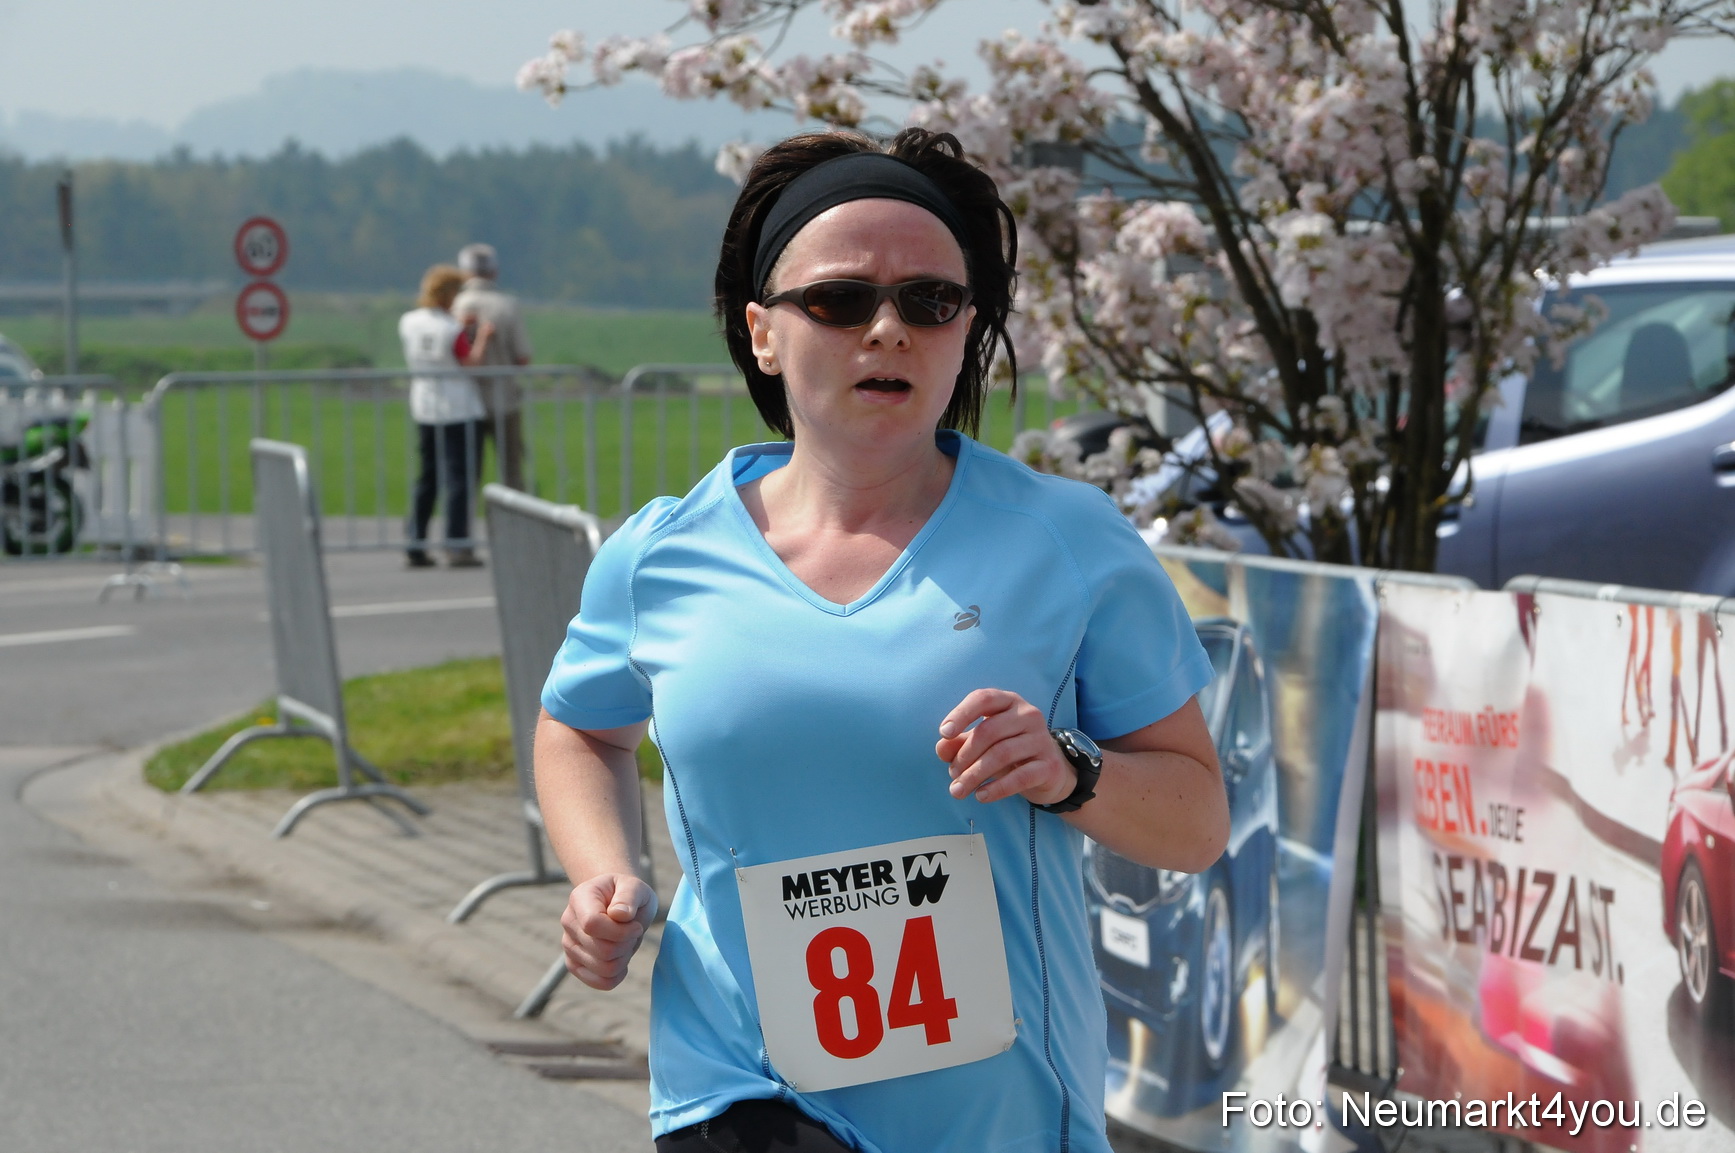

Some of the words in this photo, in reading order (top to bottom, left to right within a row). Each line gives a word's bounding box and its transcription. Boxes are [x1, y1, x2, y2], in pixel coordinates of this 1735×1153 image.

[781, 859, 897, 901] MEYER
[784, 887, 900, 920] WERBUNG
[806, 915, 958, 1059] 84
